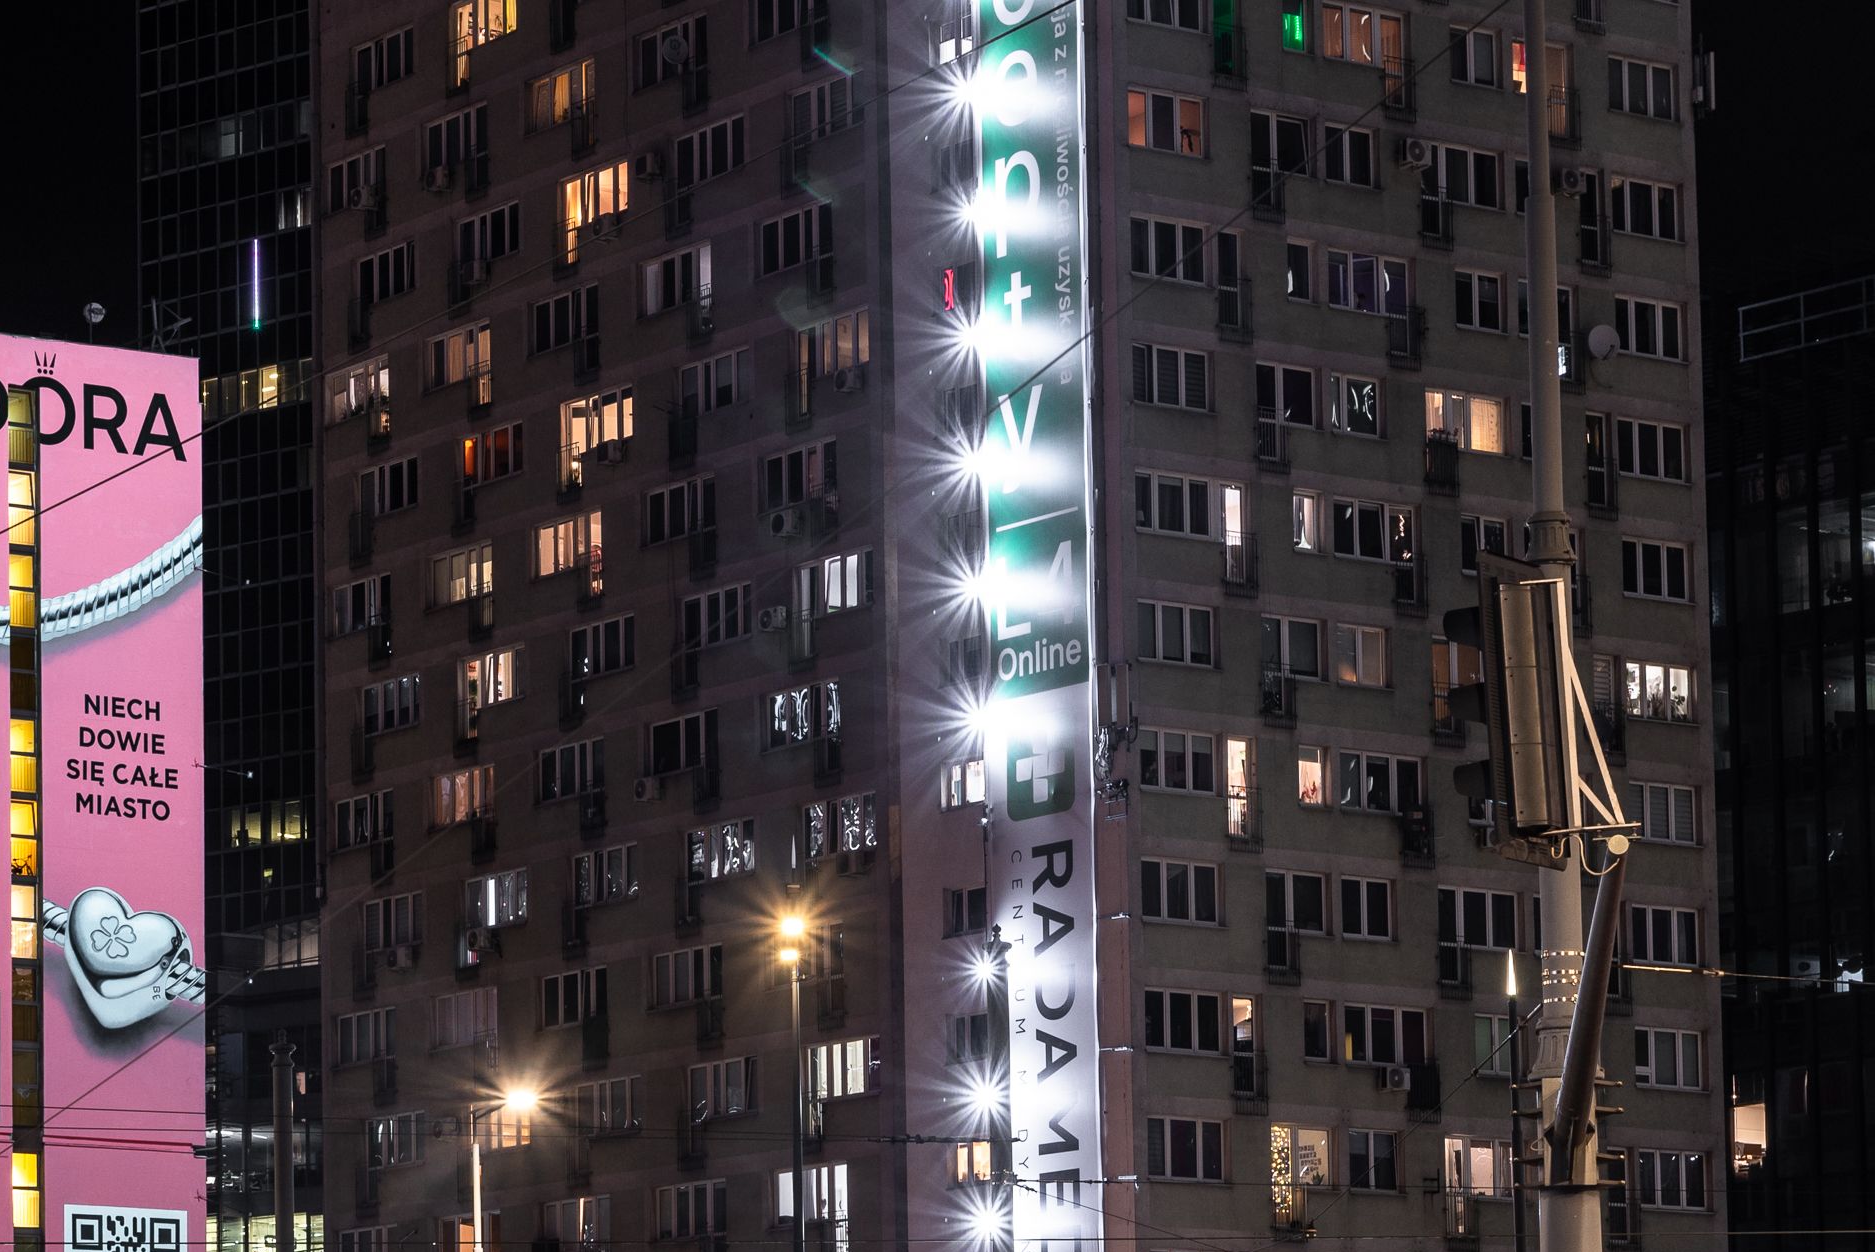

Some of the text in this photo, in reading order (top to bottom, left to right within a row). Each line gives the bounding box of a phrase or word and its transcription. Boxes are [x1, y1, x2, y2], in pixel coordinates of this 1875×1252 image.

[997, 638, 1082, 682] Online
[83, 693, 161, 722] NIECH
[78, 725, 166, 756] DOWIE
[66, 758, 180, 790] SIĘ CAŁE
[74, 792, 171, 822] MIASTO
[1010, 849, 1027, 1035] CENTUM
